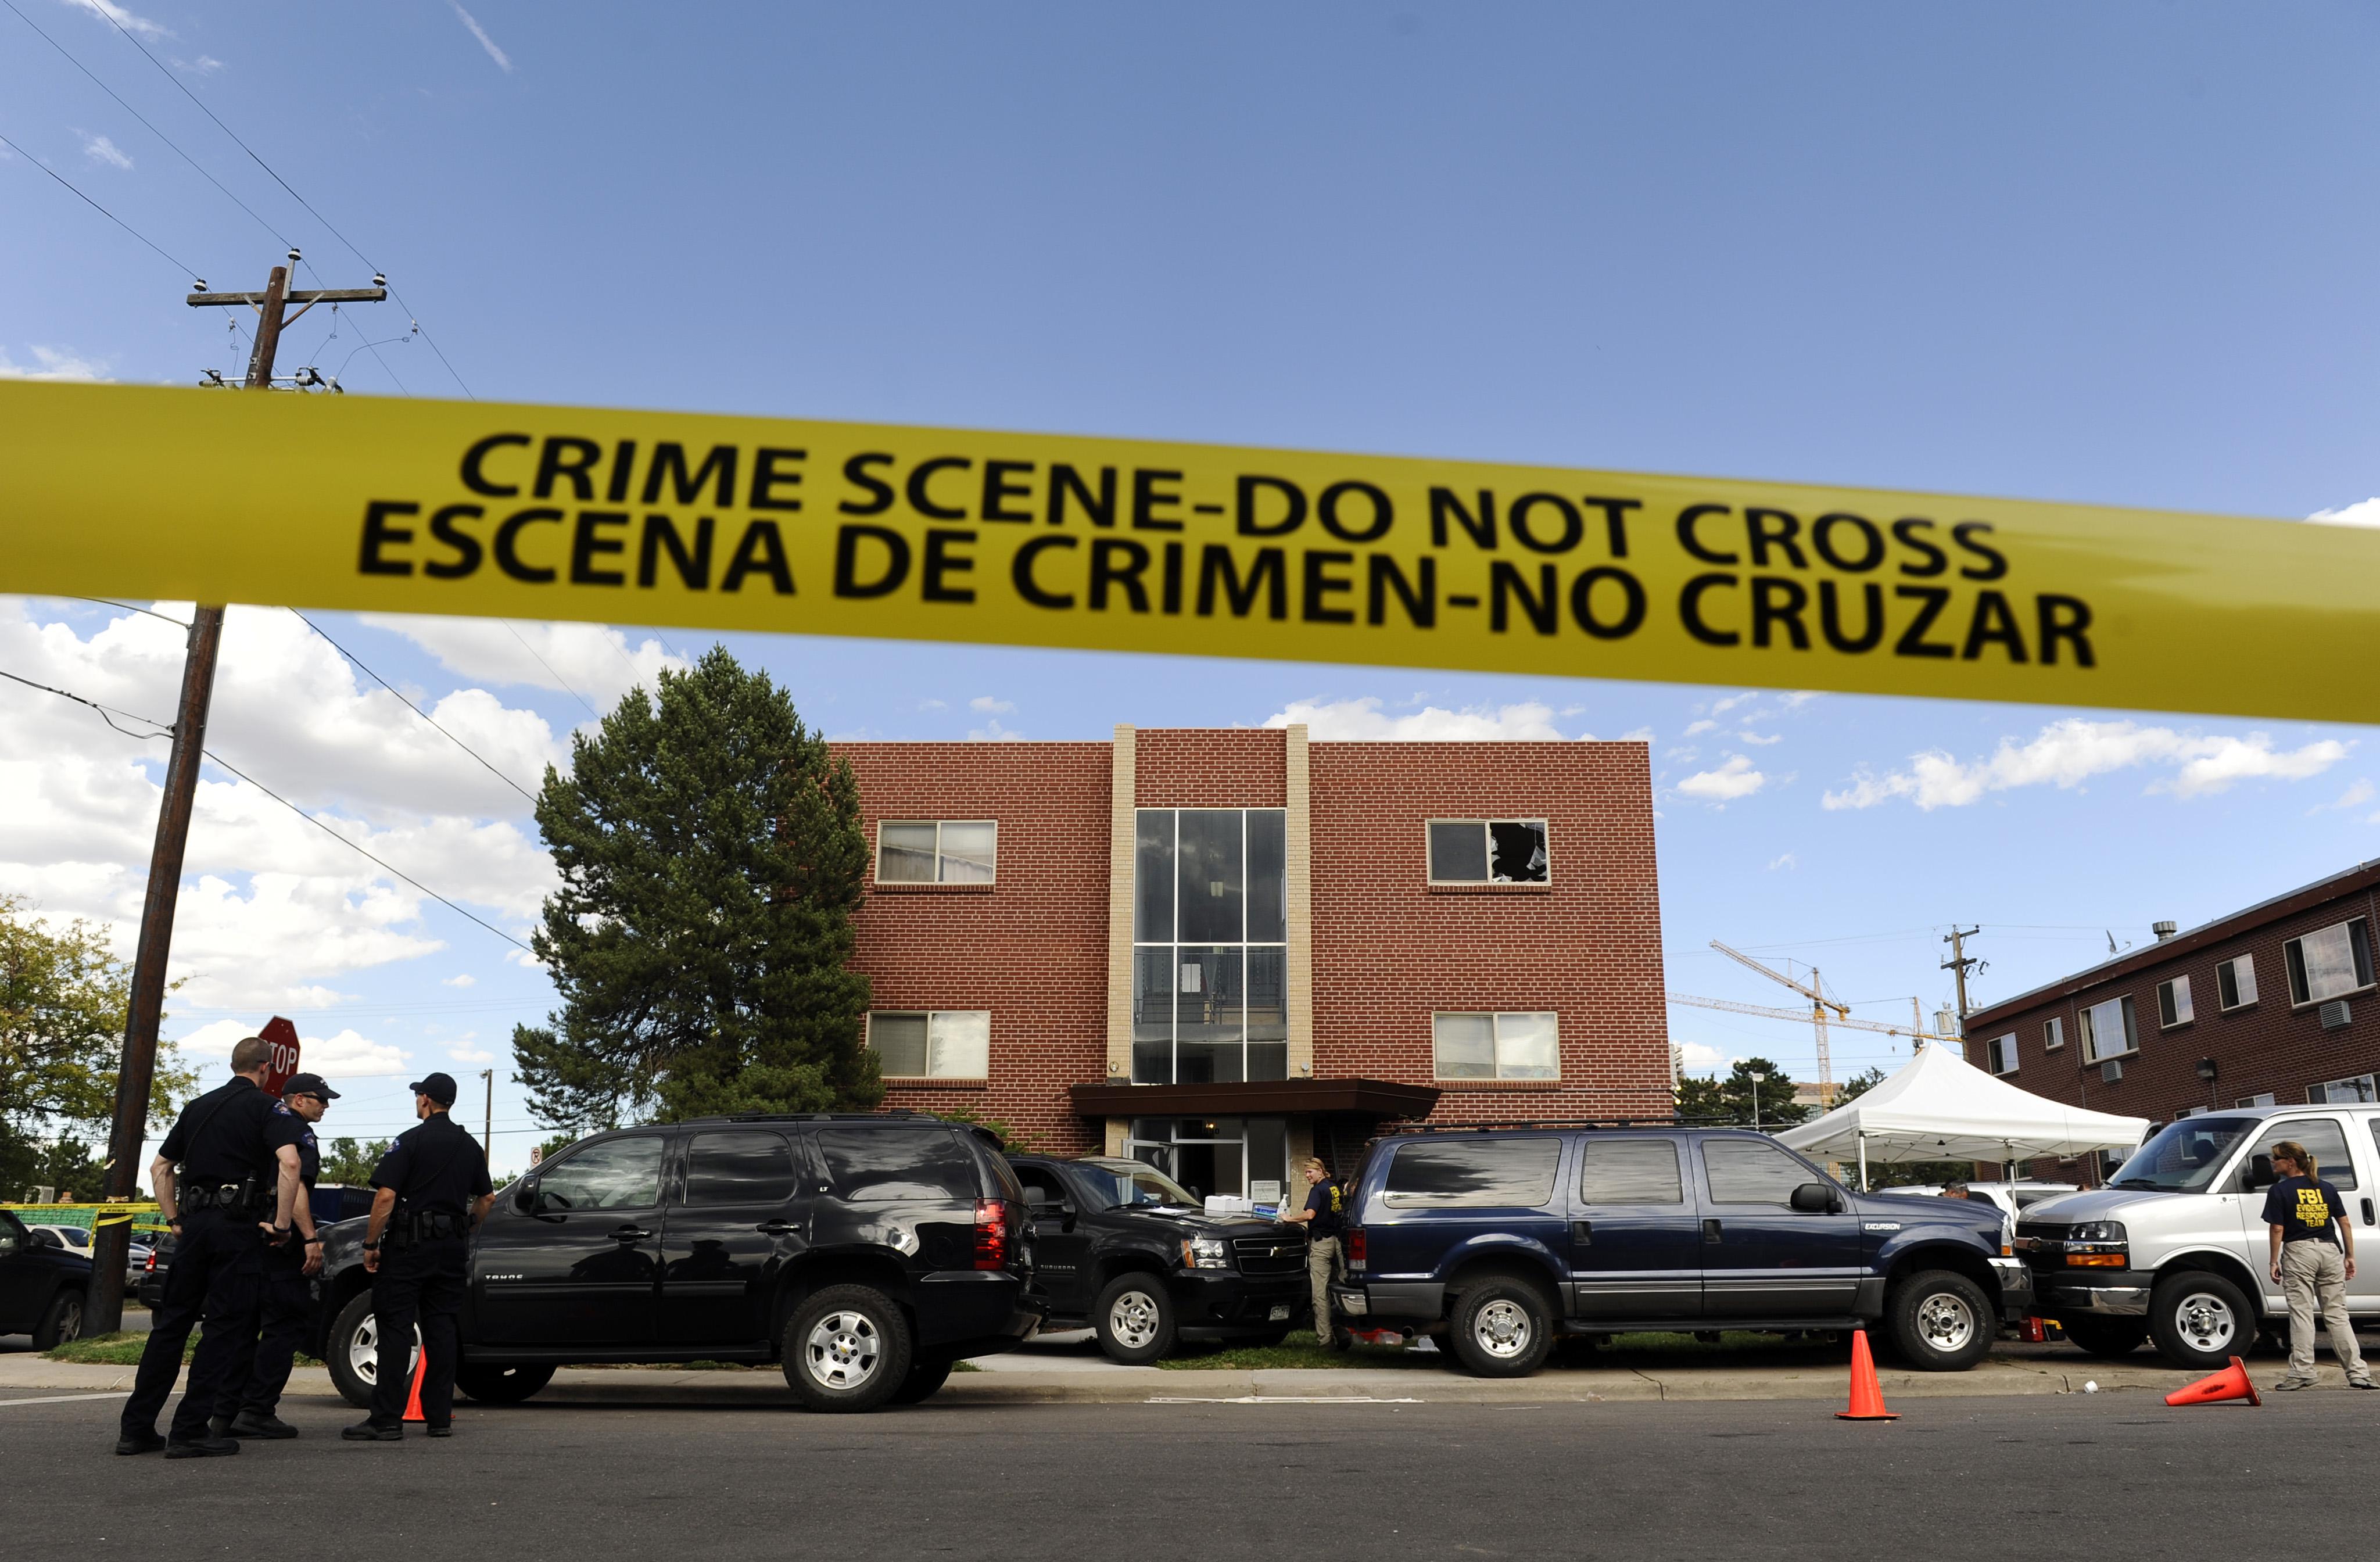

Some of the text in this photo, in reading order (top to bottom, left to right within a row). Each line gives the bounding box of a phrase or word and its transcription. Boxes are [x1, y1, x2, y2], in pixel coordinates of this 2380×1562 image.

[458, 432, 2009, 582] CRIME SCENE-DO NOT CROSS
[356, 500, 2098, 669] ESCENA DE CRIMEN-NO CRUZAR
[265, 1040, 297, 1075] TOP
[2296, 1188, 2324, 1204] FBI
[2296, 1203, 2328, 1212] EVIDENCE
[2305, 1219, 2325, 1227] TEAM
